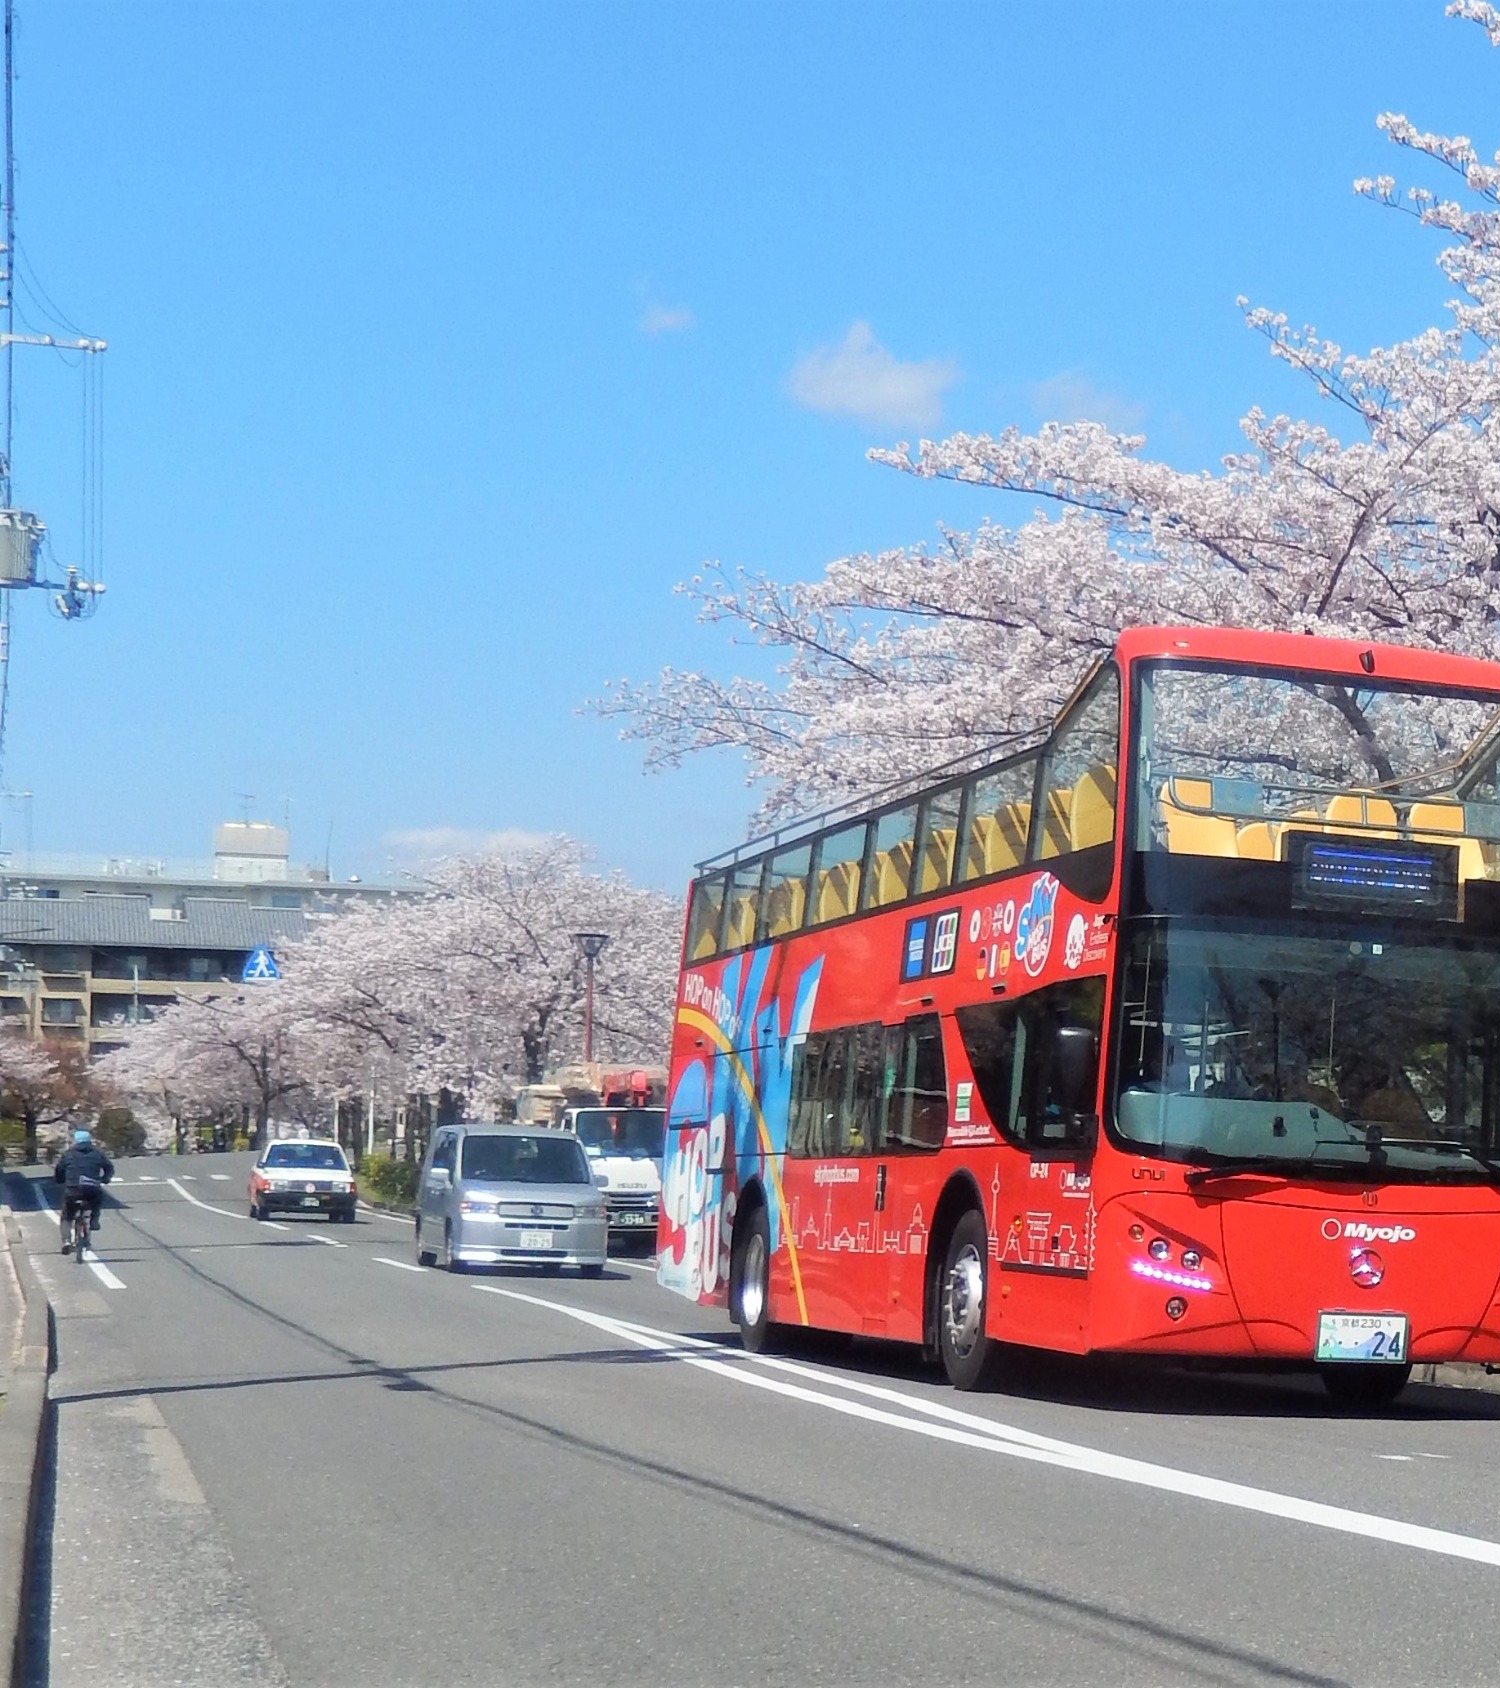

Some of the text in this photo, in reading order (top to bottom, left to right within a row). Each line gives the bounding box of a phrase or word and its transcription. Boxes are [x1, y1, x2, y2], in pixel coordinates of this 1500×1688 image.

[683, 973, 704, 1005] HOP
[701, 987, 713, 1013] on
[711, 986, 732, 1025] HOP
[1343, 1222, 1416, 1243] Myojo
[1372, 1331, 1400, 1358] 24
